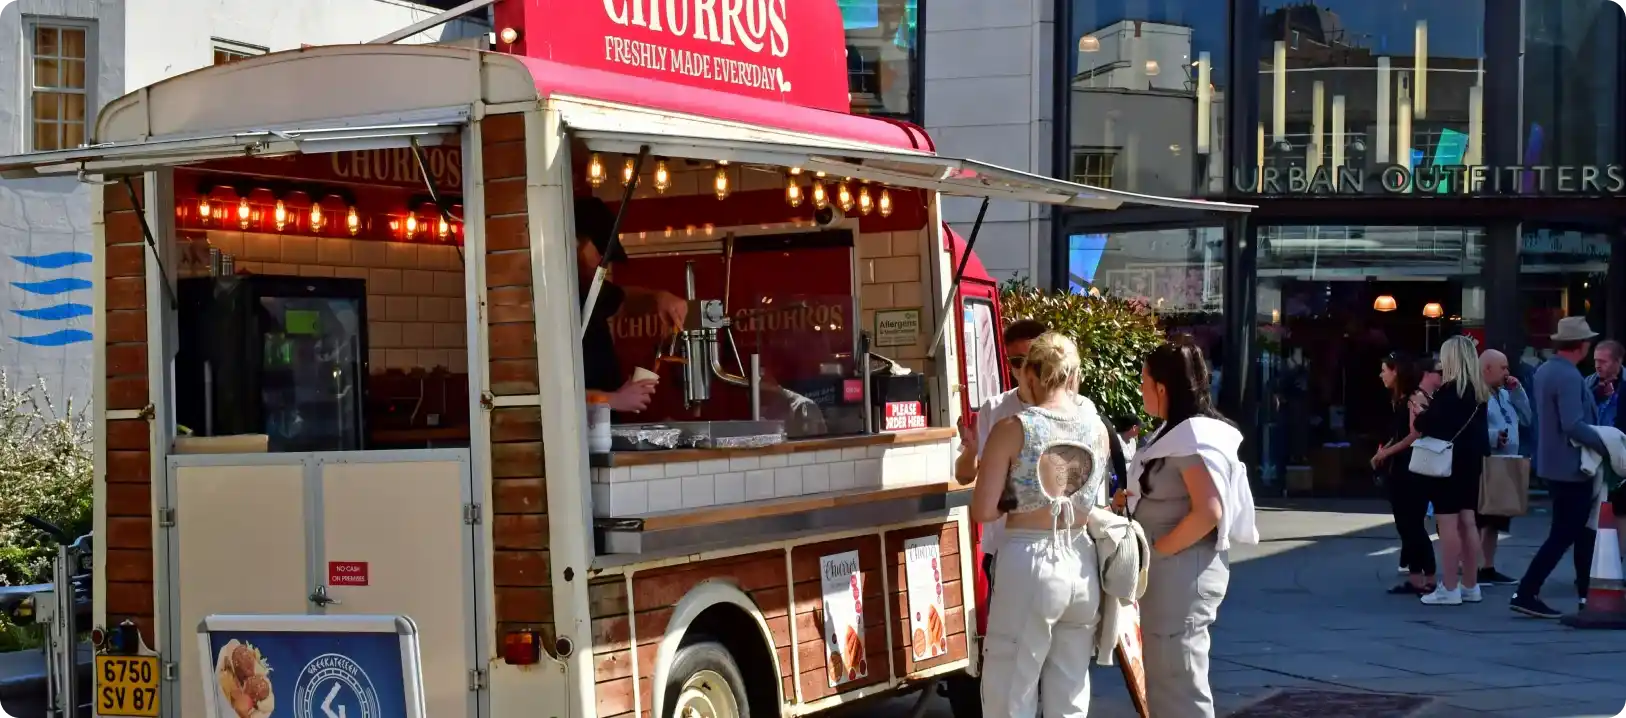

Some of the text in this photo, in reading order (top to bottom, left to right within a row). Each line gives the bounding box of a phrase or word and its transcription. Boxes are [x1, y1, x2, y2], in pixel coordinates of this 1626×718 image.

[604, 35, 777, 91] FRESHLY MADE EVERYDAY
[1233, 164, 1625, 193] URBAN OUTFITTERS
[891, 403, 917, 416] PLEASE
[908, 415, 925, 428] HERE
[824, 557, 858, 581] Churros
[104, 659, 151, 684] 6750
[306, 657, 359, 677] GREEKATESSEN
[102, 687, 156, 711] SV 87
